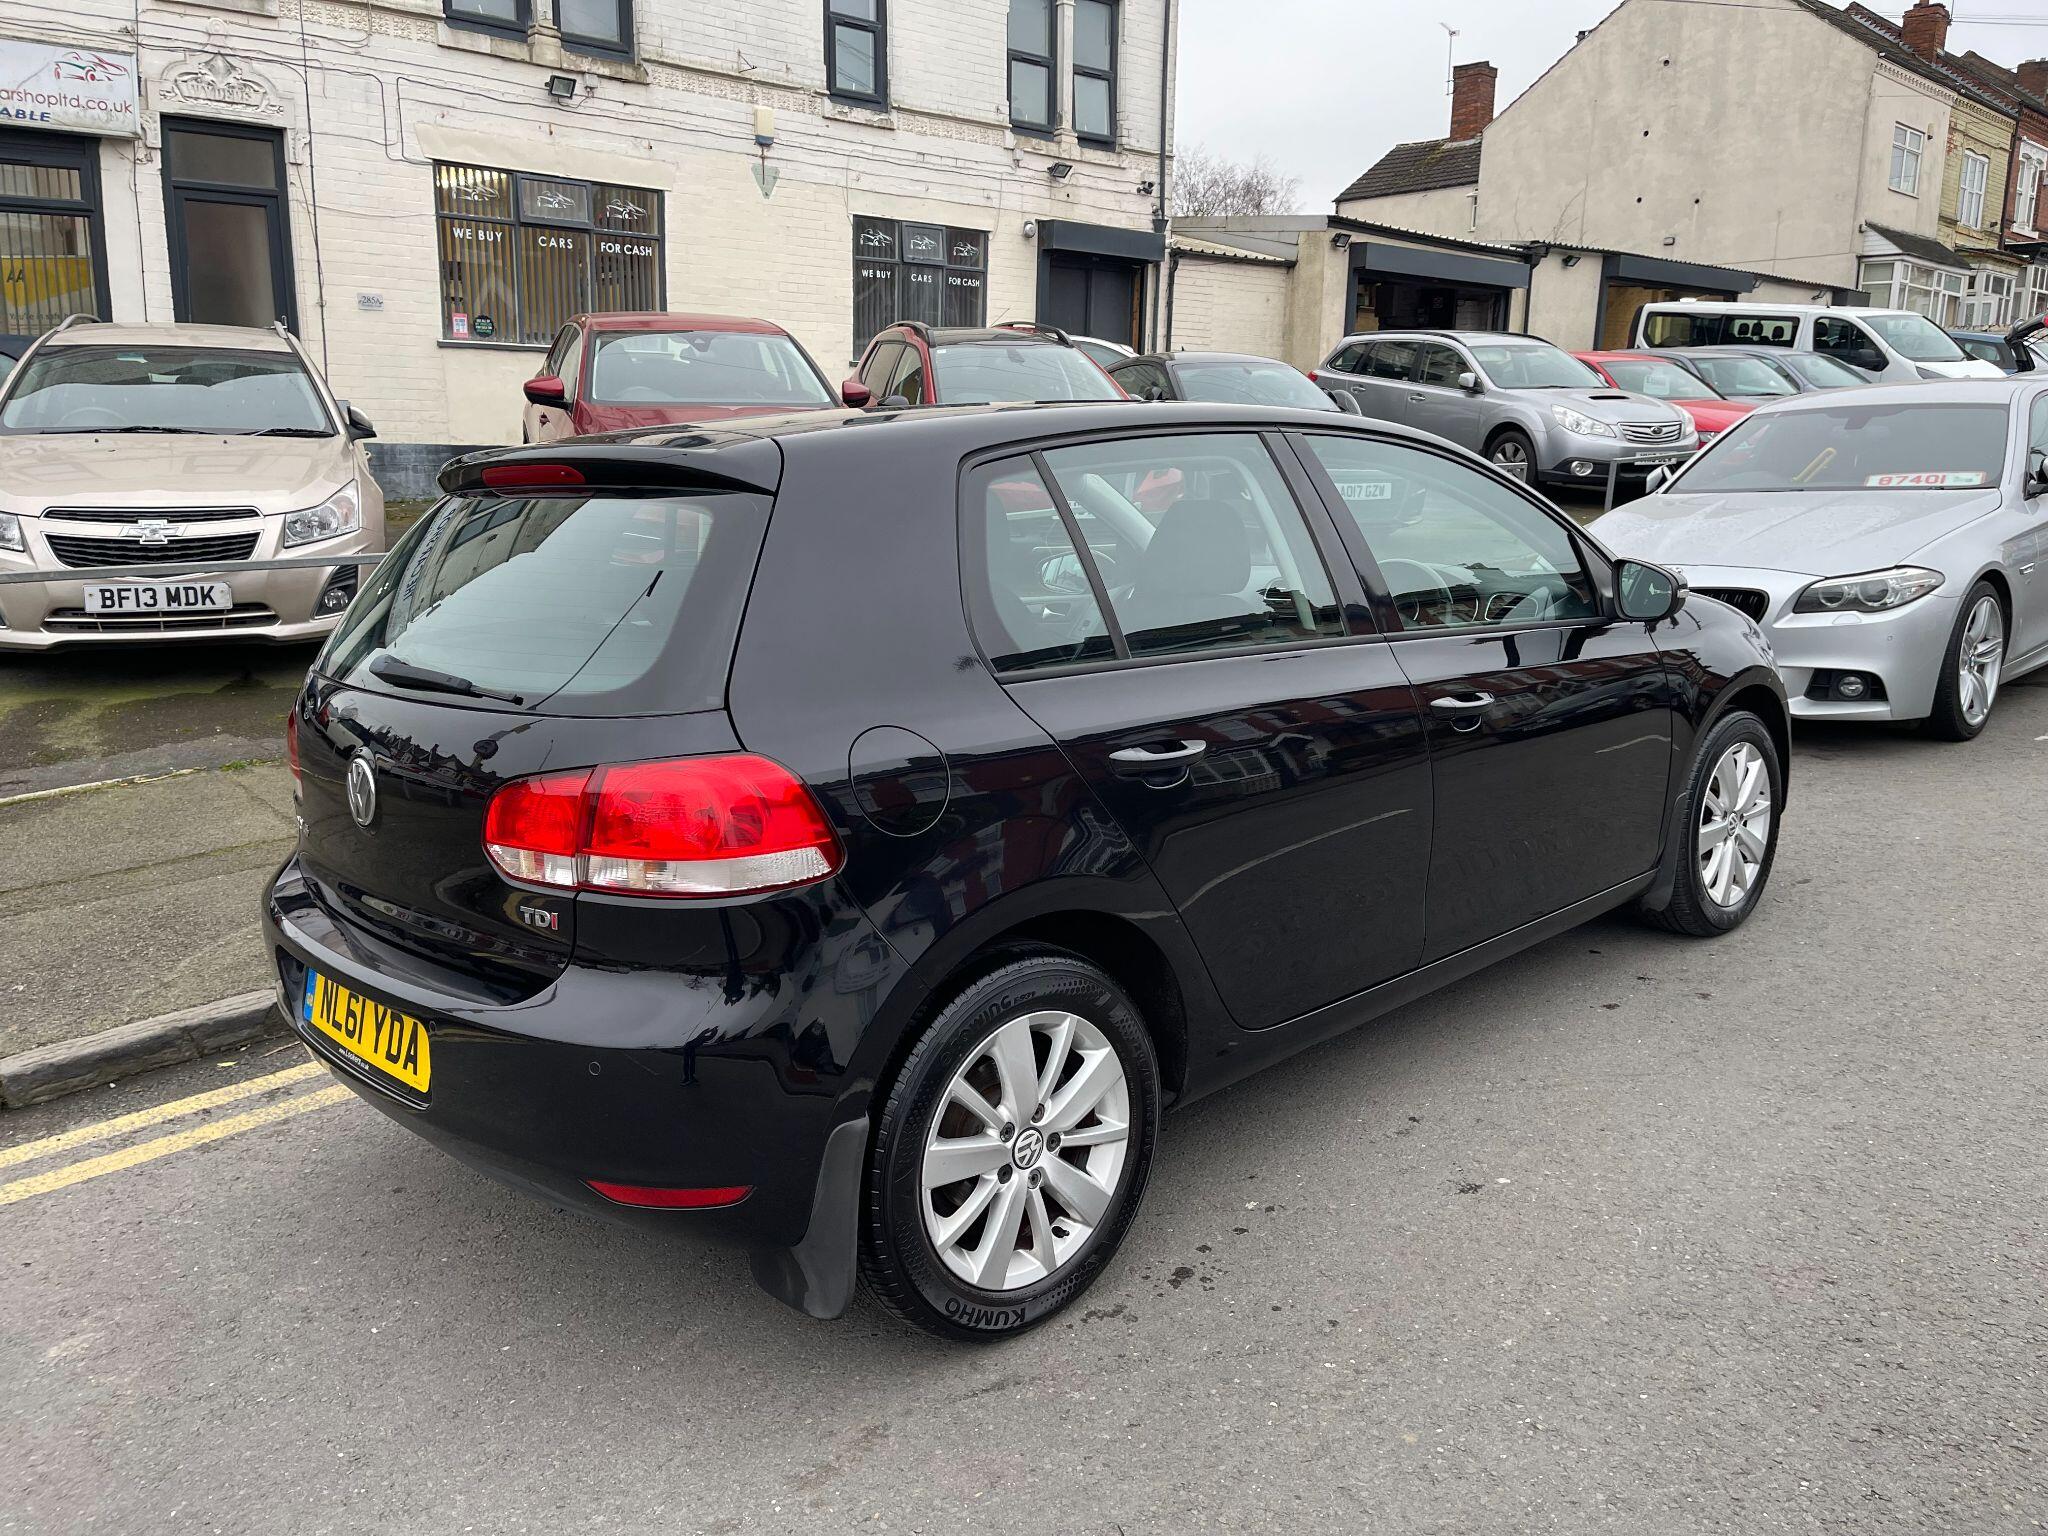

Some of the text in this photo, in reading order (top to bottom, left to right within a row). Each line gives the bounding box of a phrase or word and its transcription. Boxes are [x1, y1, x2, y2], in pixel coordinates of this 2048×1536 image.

[453, 227, 652, 257] WE BUY CARS FOR CASH
[861, 269, 980, 288] WE BUY CARS FOR CASH
[98, 585, 217, 609] BF13 MDK
[320, 977, 419, 1077] NL61 YDA
[944, 1297, 1026, 1328] KUMHO
